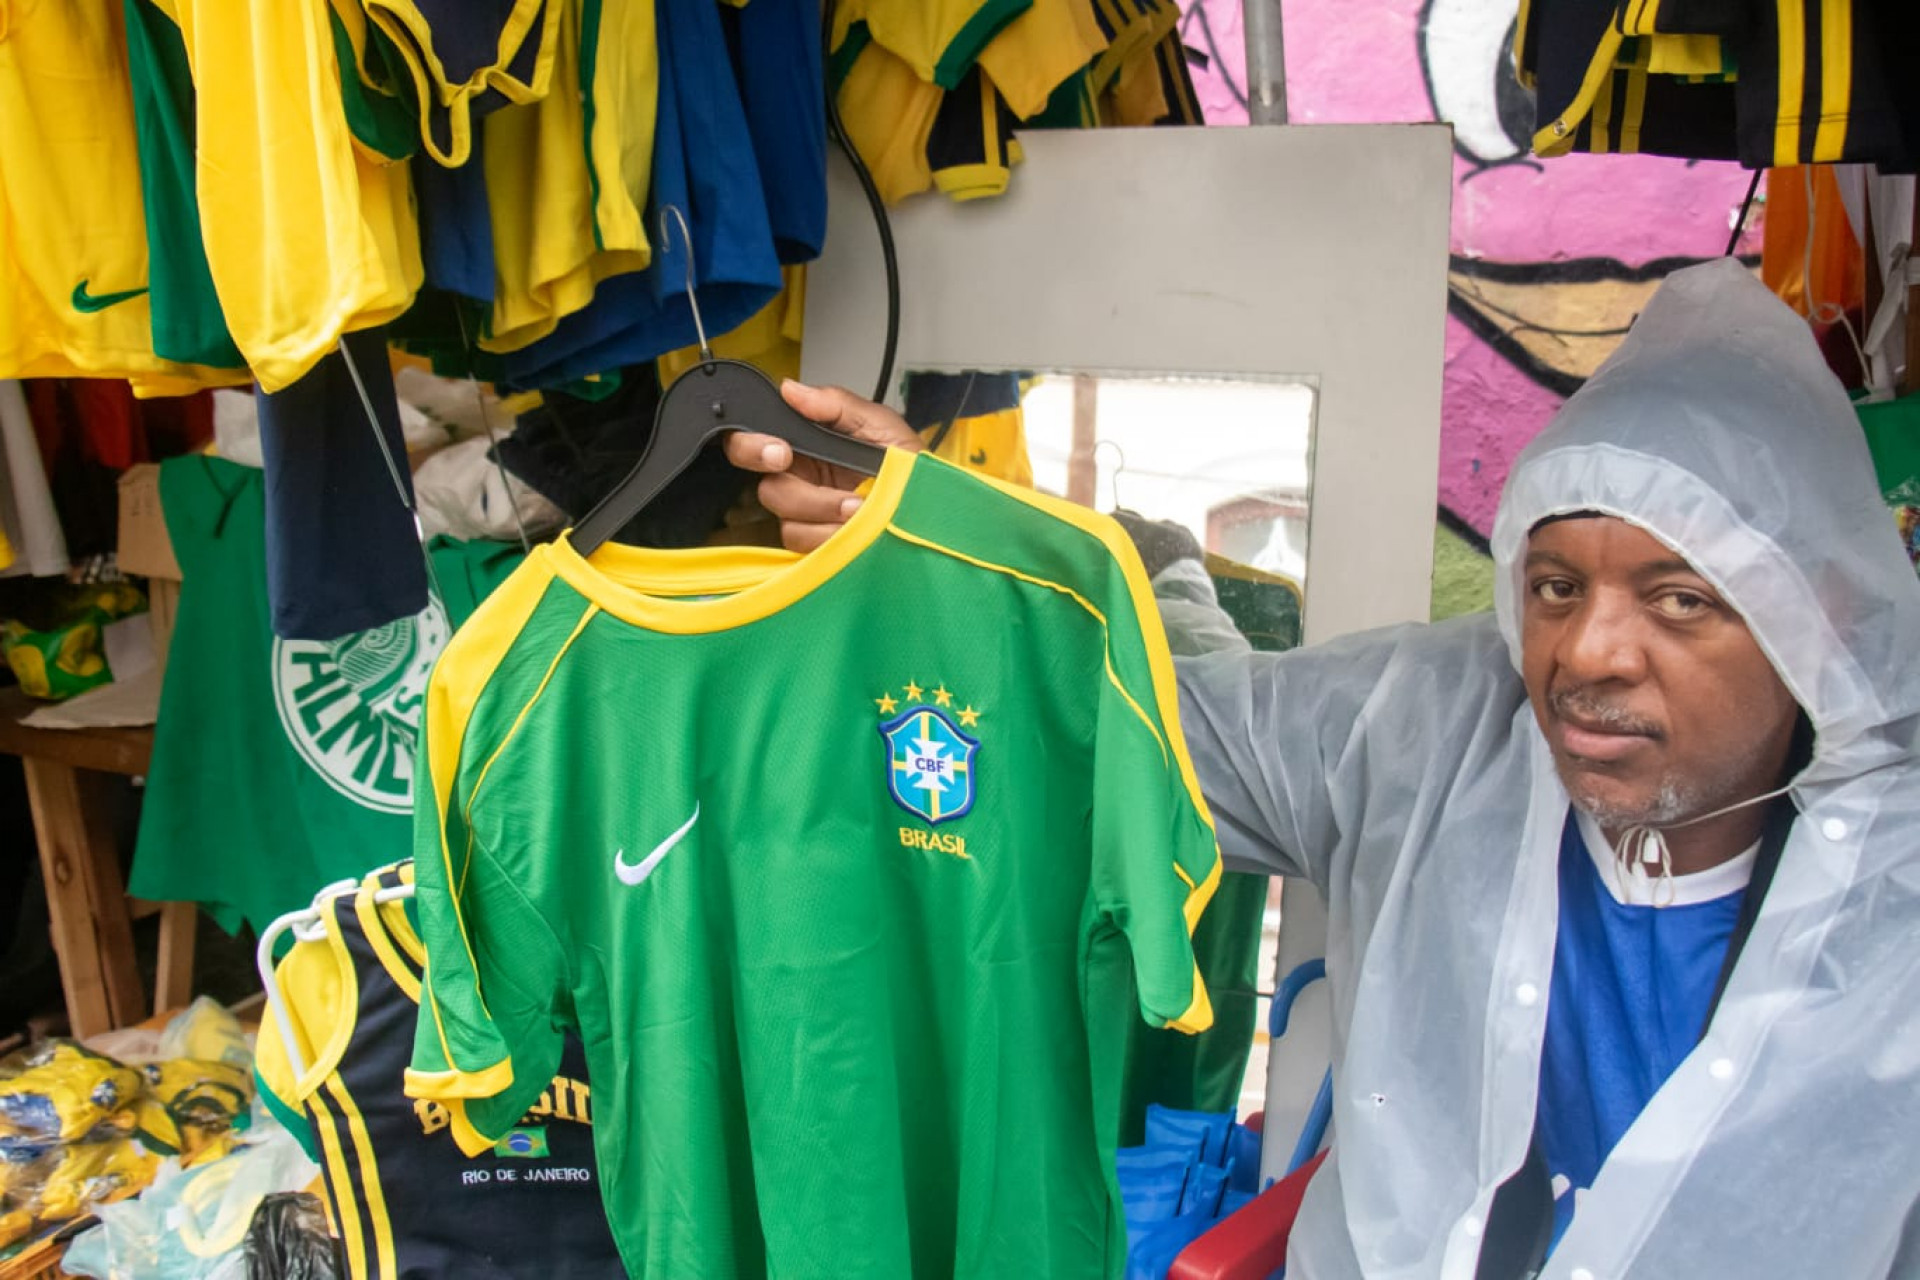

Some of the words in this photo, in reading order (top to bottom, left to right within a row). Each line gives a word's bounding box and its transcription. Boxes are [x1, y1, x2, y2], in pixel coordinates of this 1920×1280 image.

[915, 757, 945, 773] CBF
[899, 827, 971, 859] BRASIL
[462, 1169, 491, 1185] RIO
[496, 1168, 518, 1181] DE
[523, 1167, 591, 1182] JANEIRO
